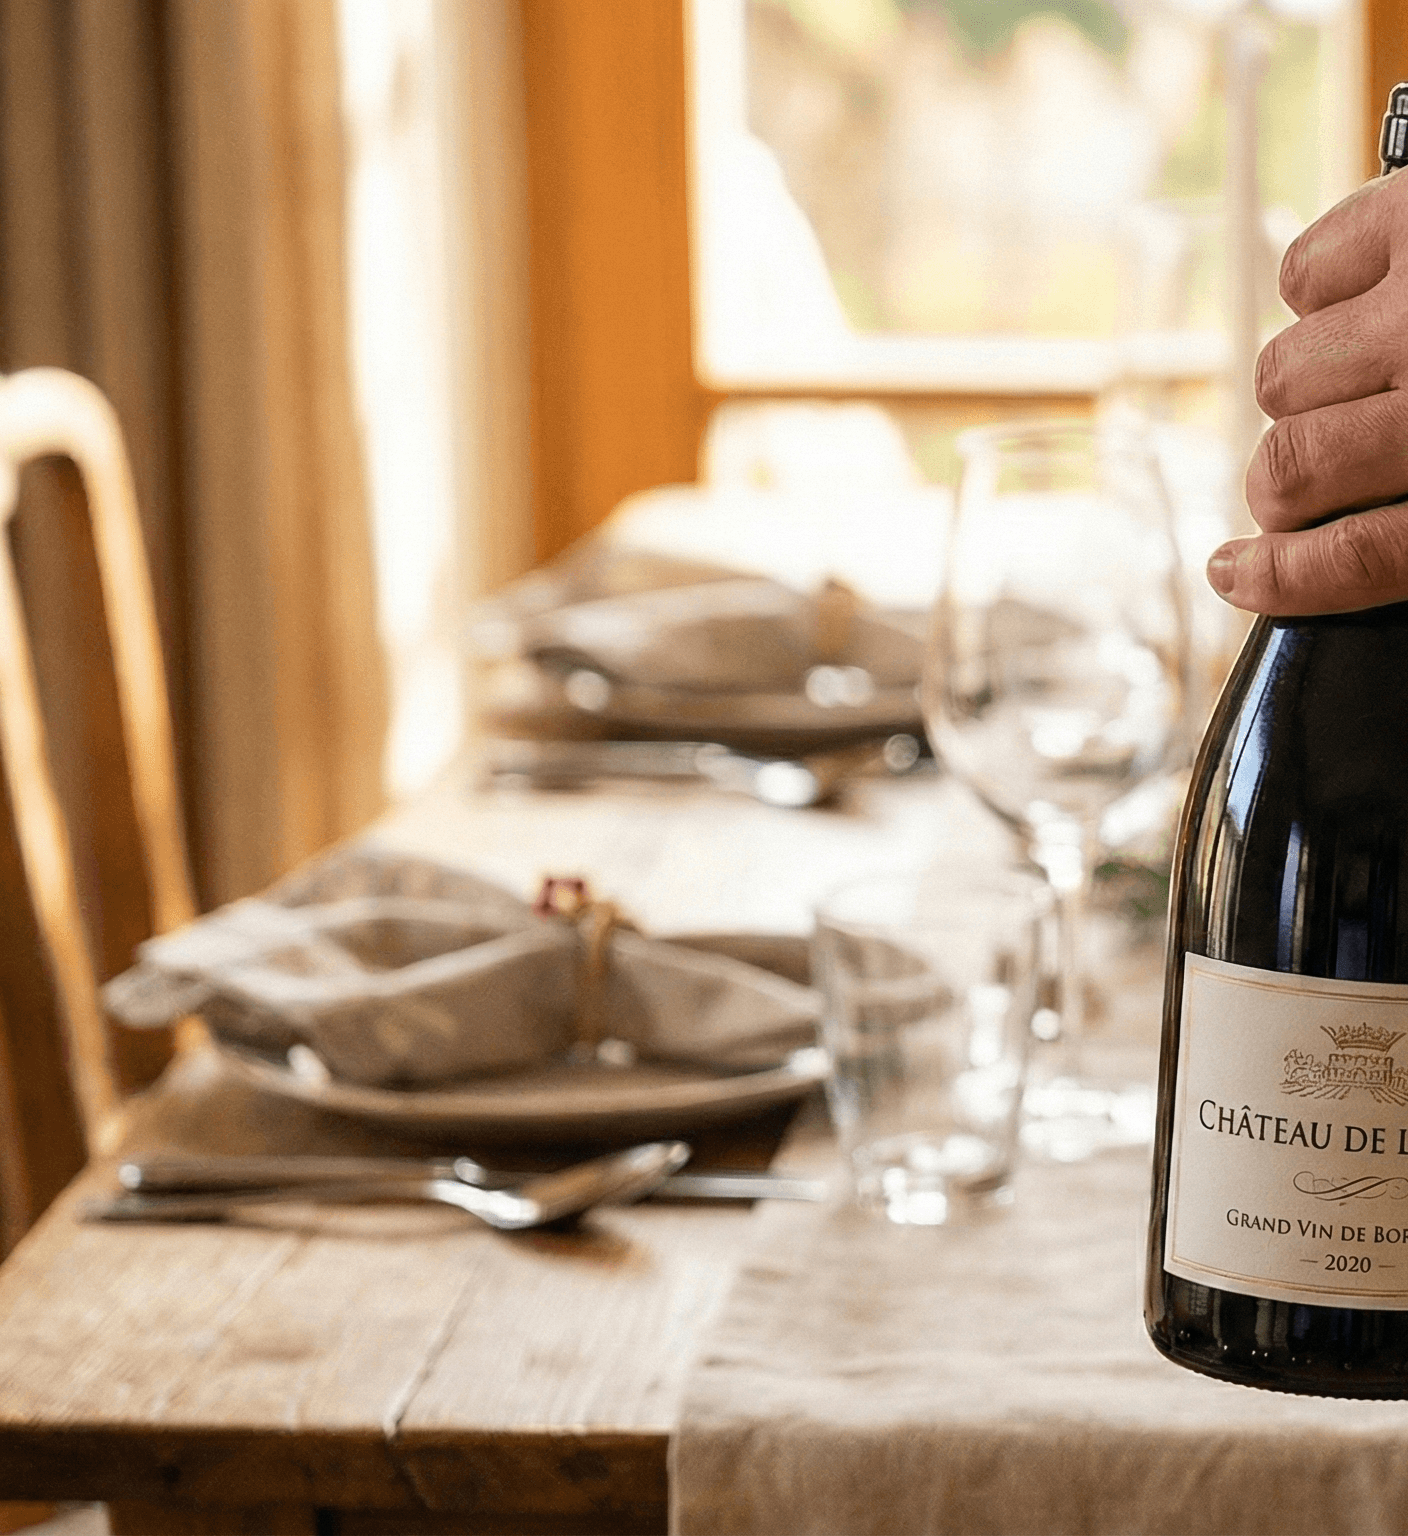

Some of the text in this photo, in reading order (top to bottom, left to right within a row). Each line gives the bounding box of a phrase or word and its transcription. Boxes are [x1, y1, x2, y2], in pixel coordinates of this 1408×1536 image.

[1199, 1099, 1332, 1150] CHÂTEAU
[1344, 1125, 1385, 1154] DE
[1226, 1208, 1291, 1235] GRAND
[1297, 1219, 1333, 1240] VIN
[1341, 1225, 1366, 1243] DE
